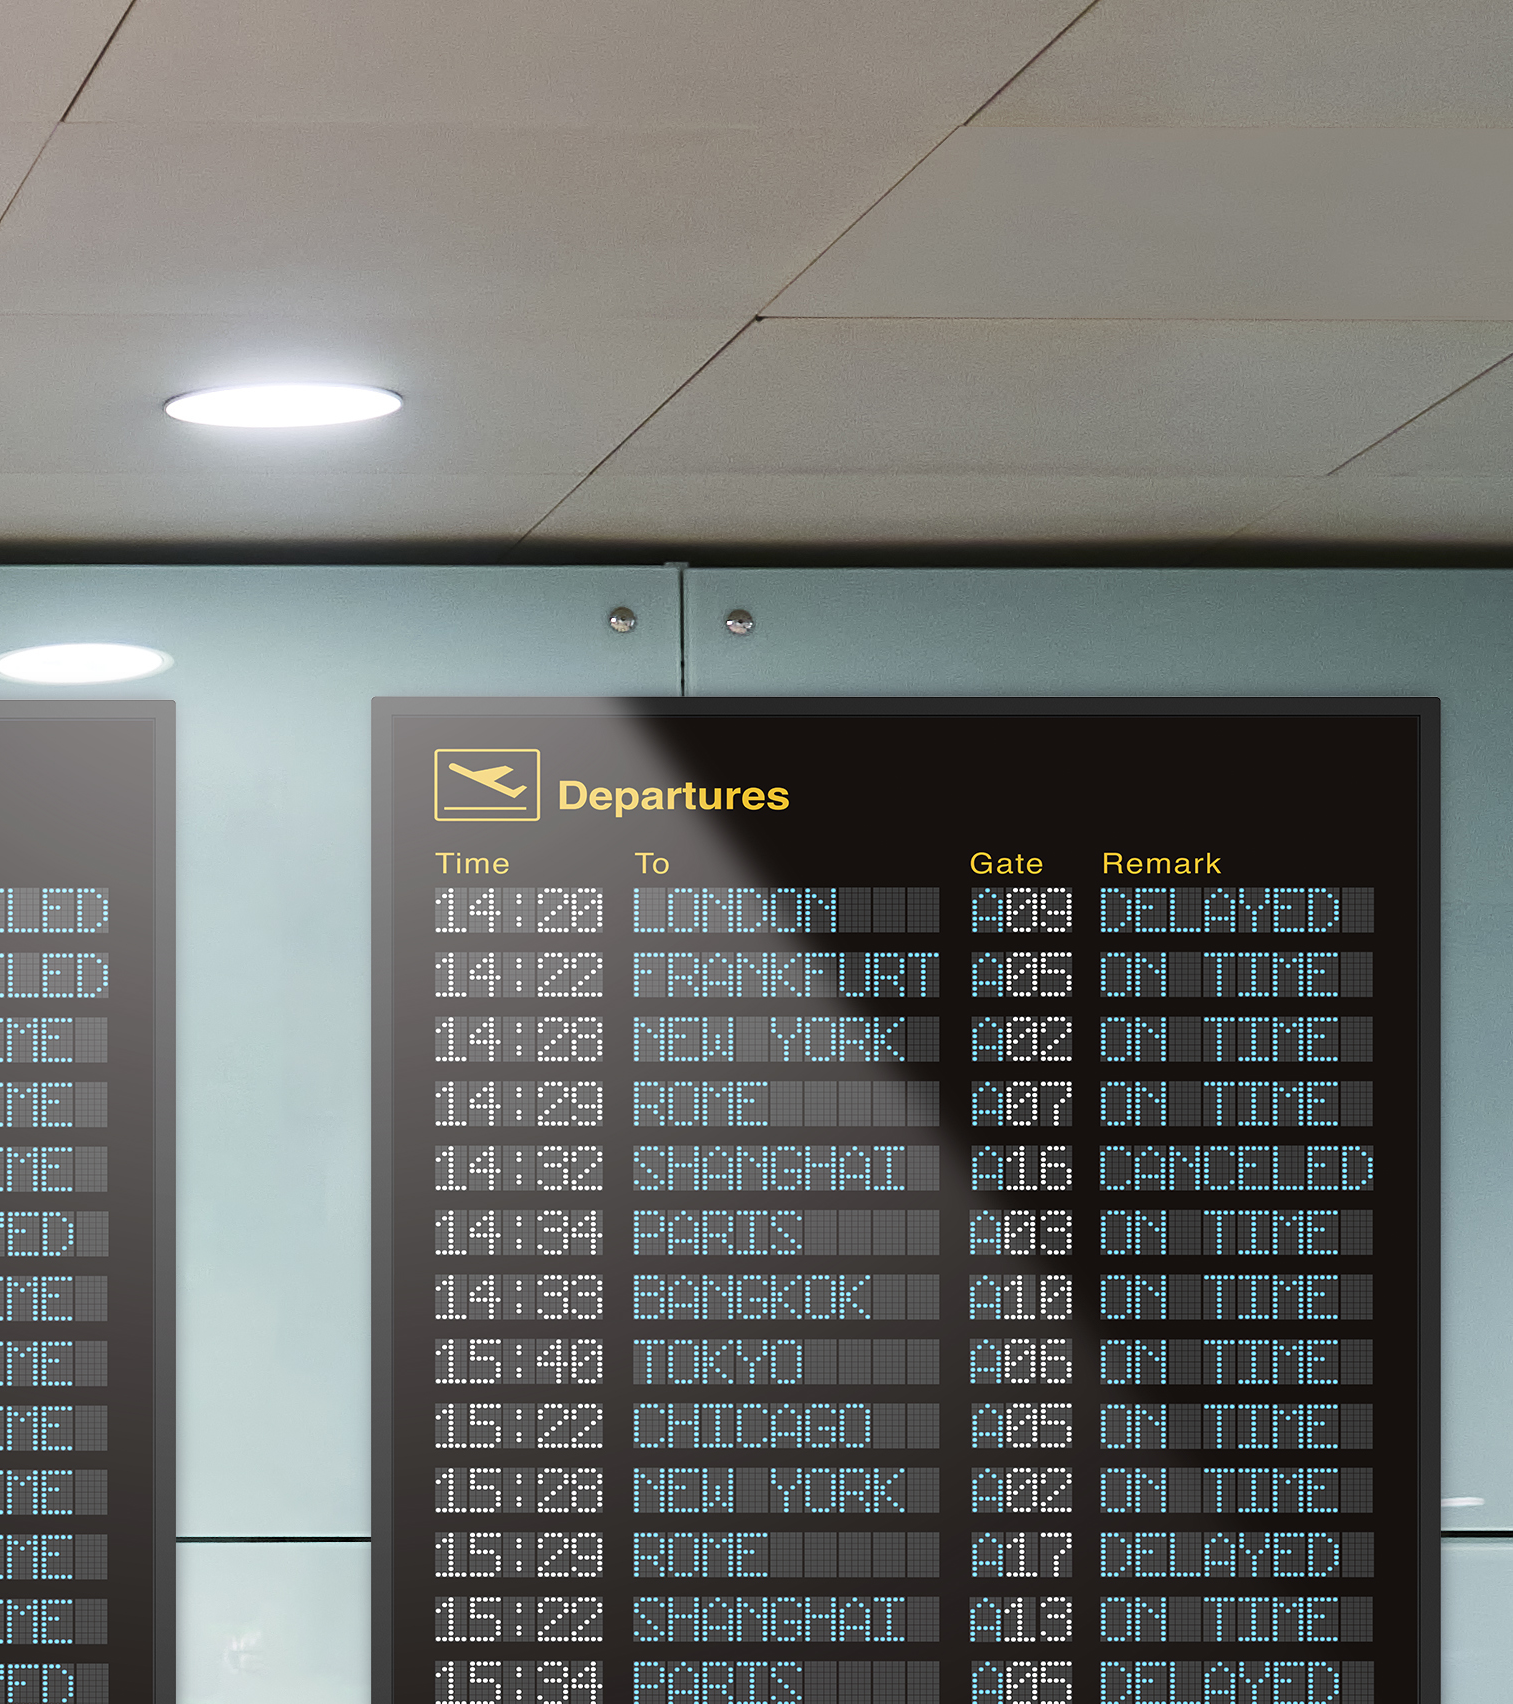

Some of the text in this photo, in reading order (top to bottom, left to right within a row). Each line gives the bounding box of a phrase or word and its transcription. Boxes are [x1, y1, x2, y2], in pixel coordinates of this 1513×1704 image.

[560, 781, 789, 817] Departures
[435, 852, 1221, 874] Time To Gate Remark
[436, 888, 1339, 932] 14:20 LONDON A09 DELAYED
[436, 1017, 1338, 1061] 14:28 NEW YORK A02 ON TIME
[436, 1146, 1373, 1190] 14:32 SHANGHAI A16 CANCELED
[436, 1275, 1338, 1319] 14:33 BANGKOK A10 ON TIME
[436, 1404, 1338, 1448] 15:22 CHICAGO A05 ON TIME
[436, 1533, 1339, 1577] 15:29 ROME A17 DELAYED
[436, 1662, 602, 1704] 15:34
